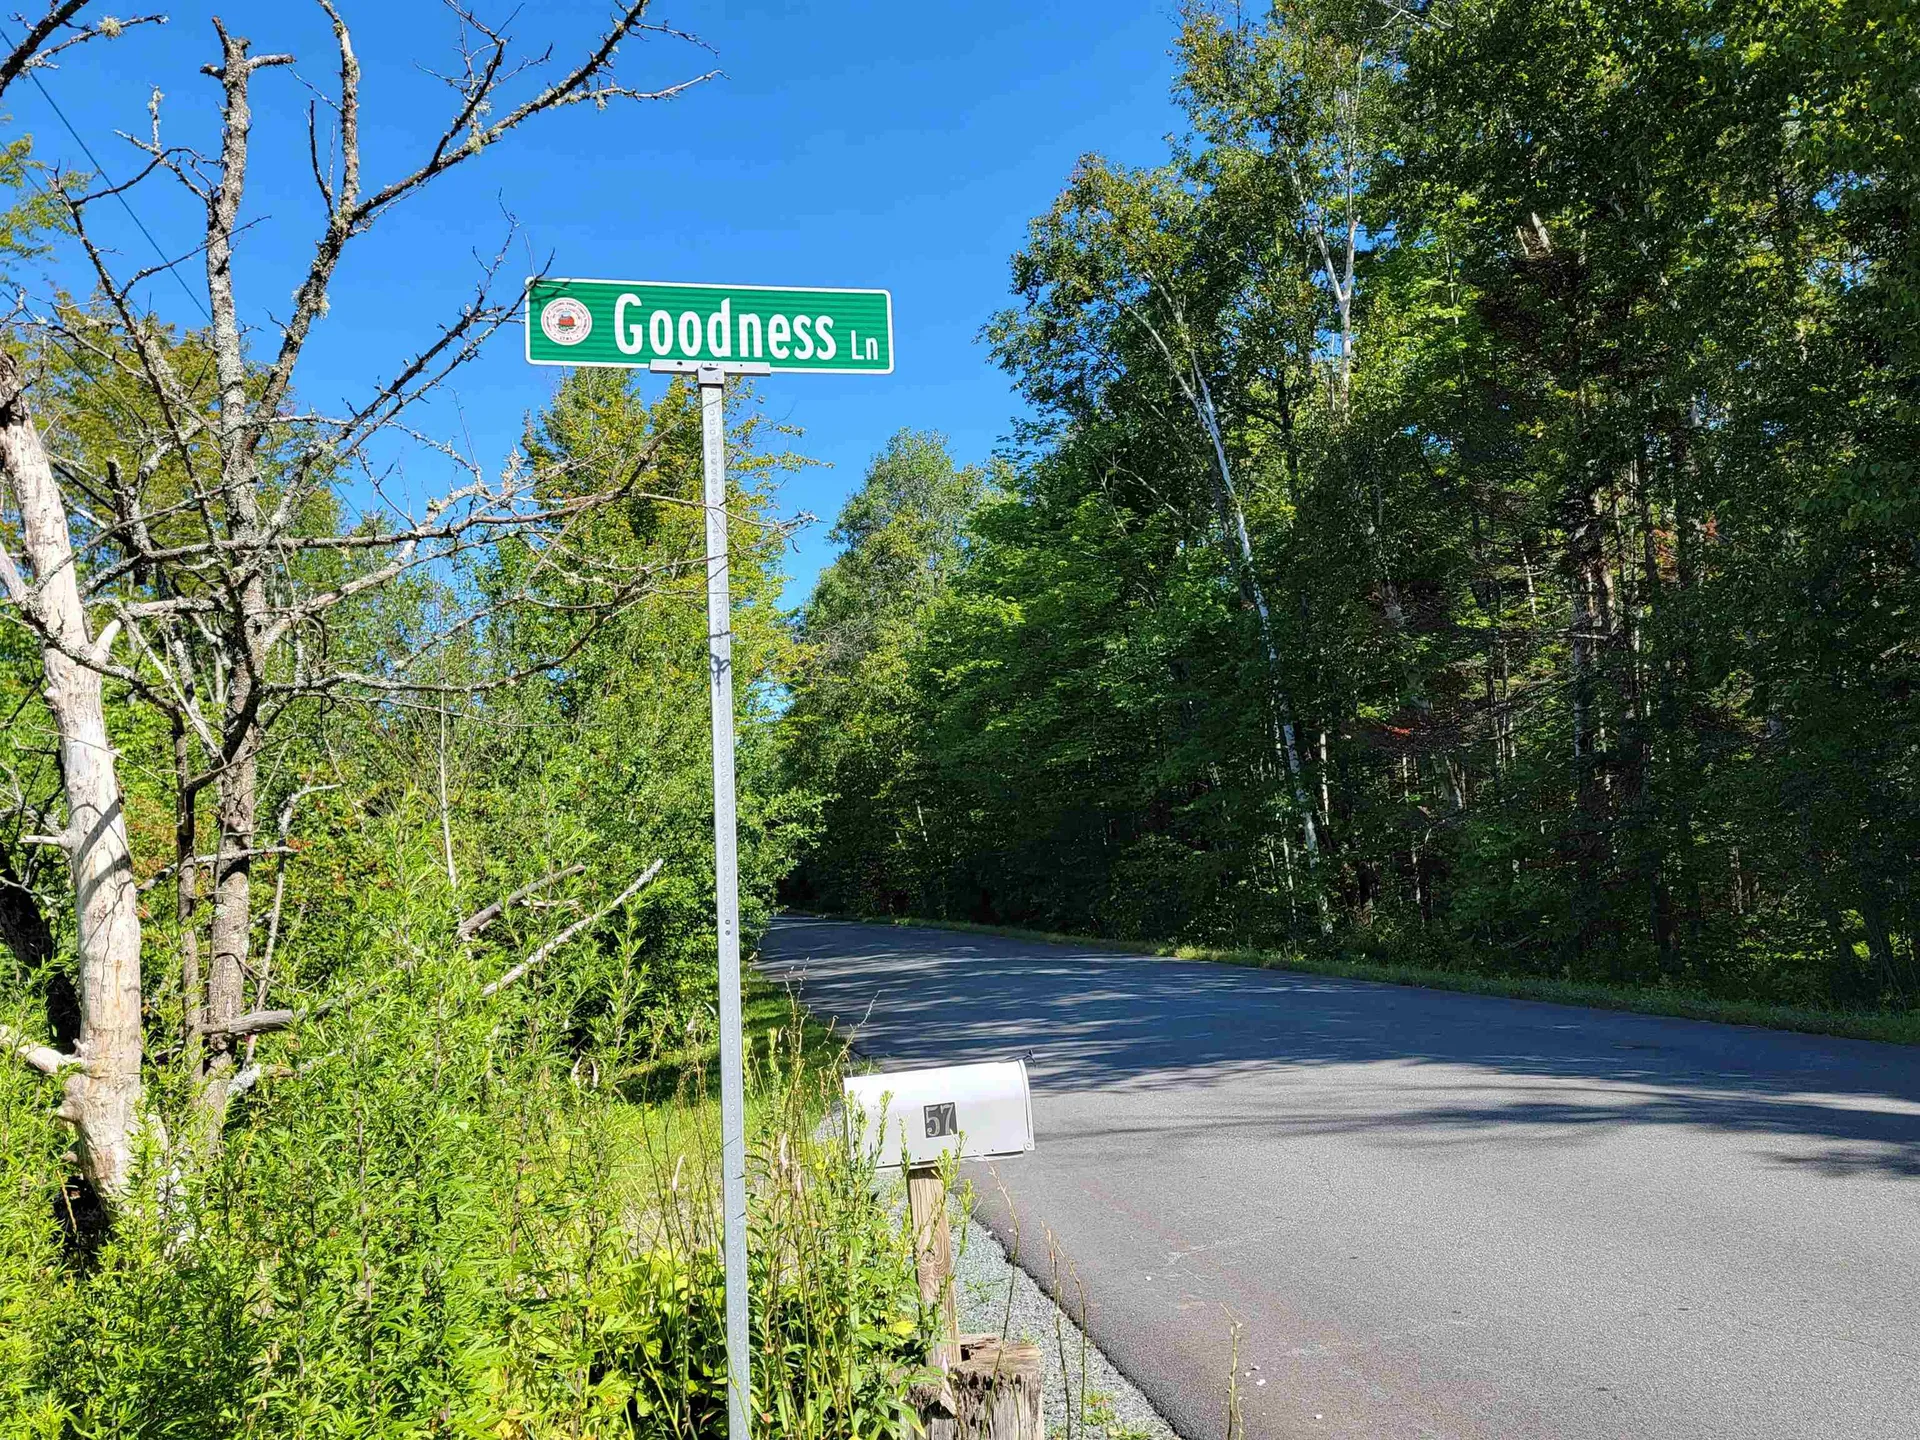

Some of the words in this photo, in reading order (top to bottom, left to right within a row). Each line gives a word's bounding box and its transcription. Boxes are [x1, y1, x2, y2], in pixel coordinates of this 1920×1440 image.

[614, 293, 837, 360] Goodness
[850, 330, 879, 361] Ln
[925, 1104, 954, 1136] 57
